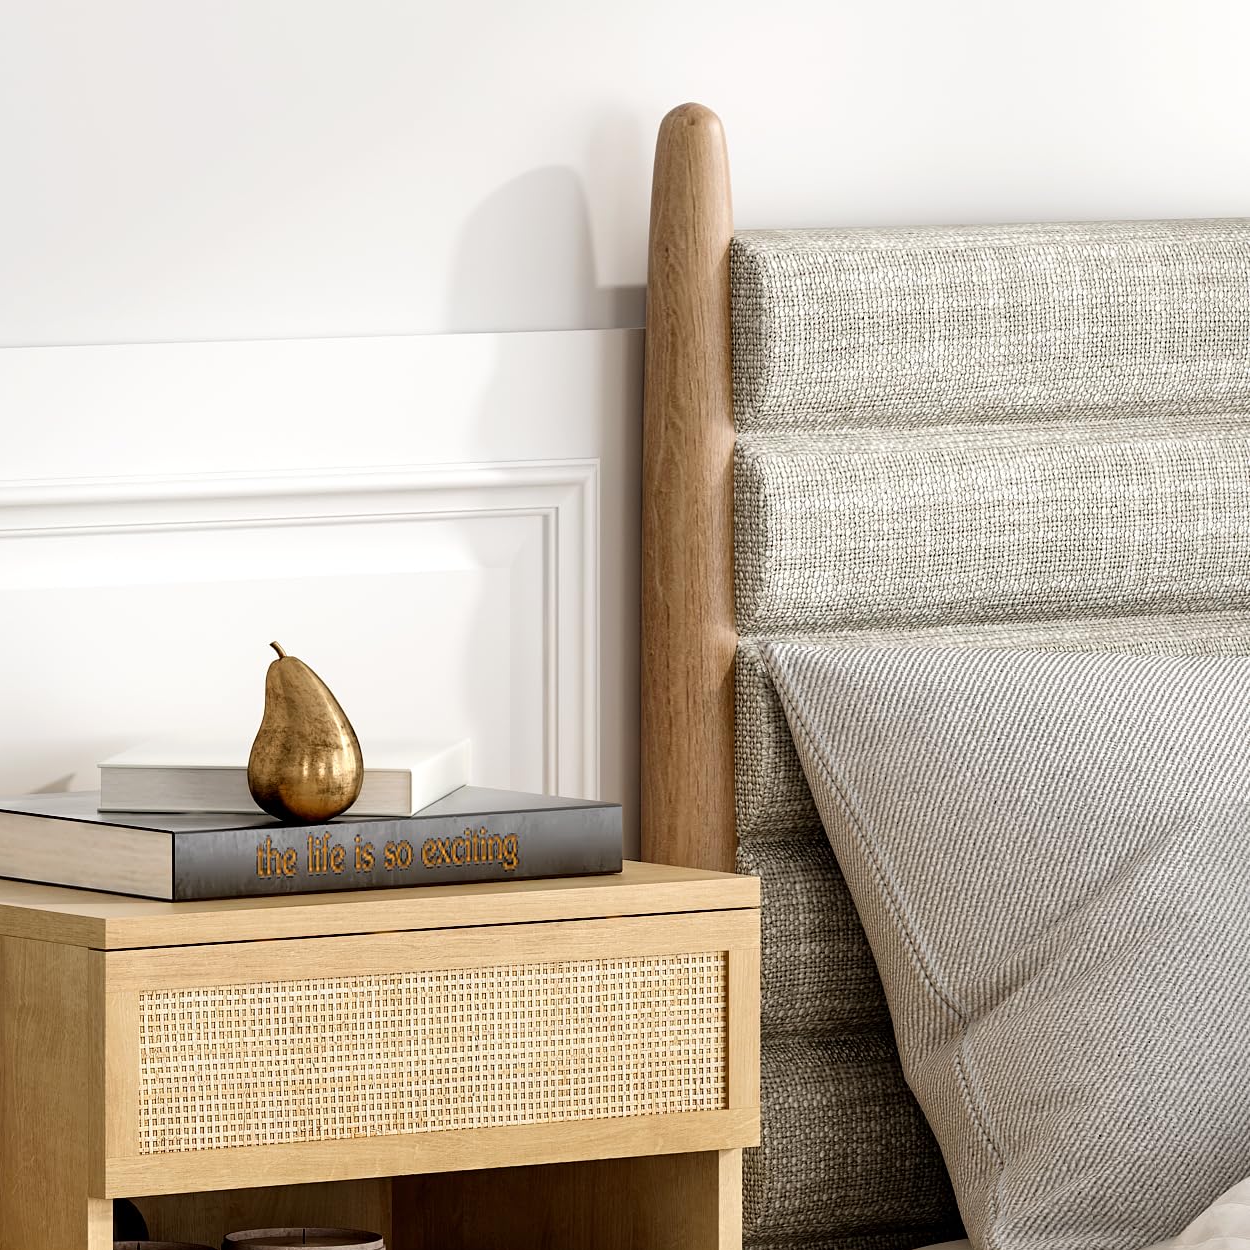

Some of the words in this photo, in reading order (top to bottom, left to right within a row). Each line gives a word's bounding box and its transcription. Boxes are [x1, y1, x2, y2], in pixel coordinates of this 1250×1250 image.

[256, 834, 297, 879] the
[307, 831, 346, 875] life
[354, 833, 375, 873] is
[383, 839, 413, 871] so
[421, 826, 520, 872] exciting
